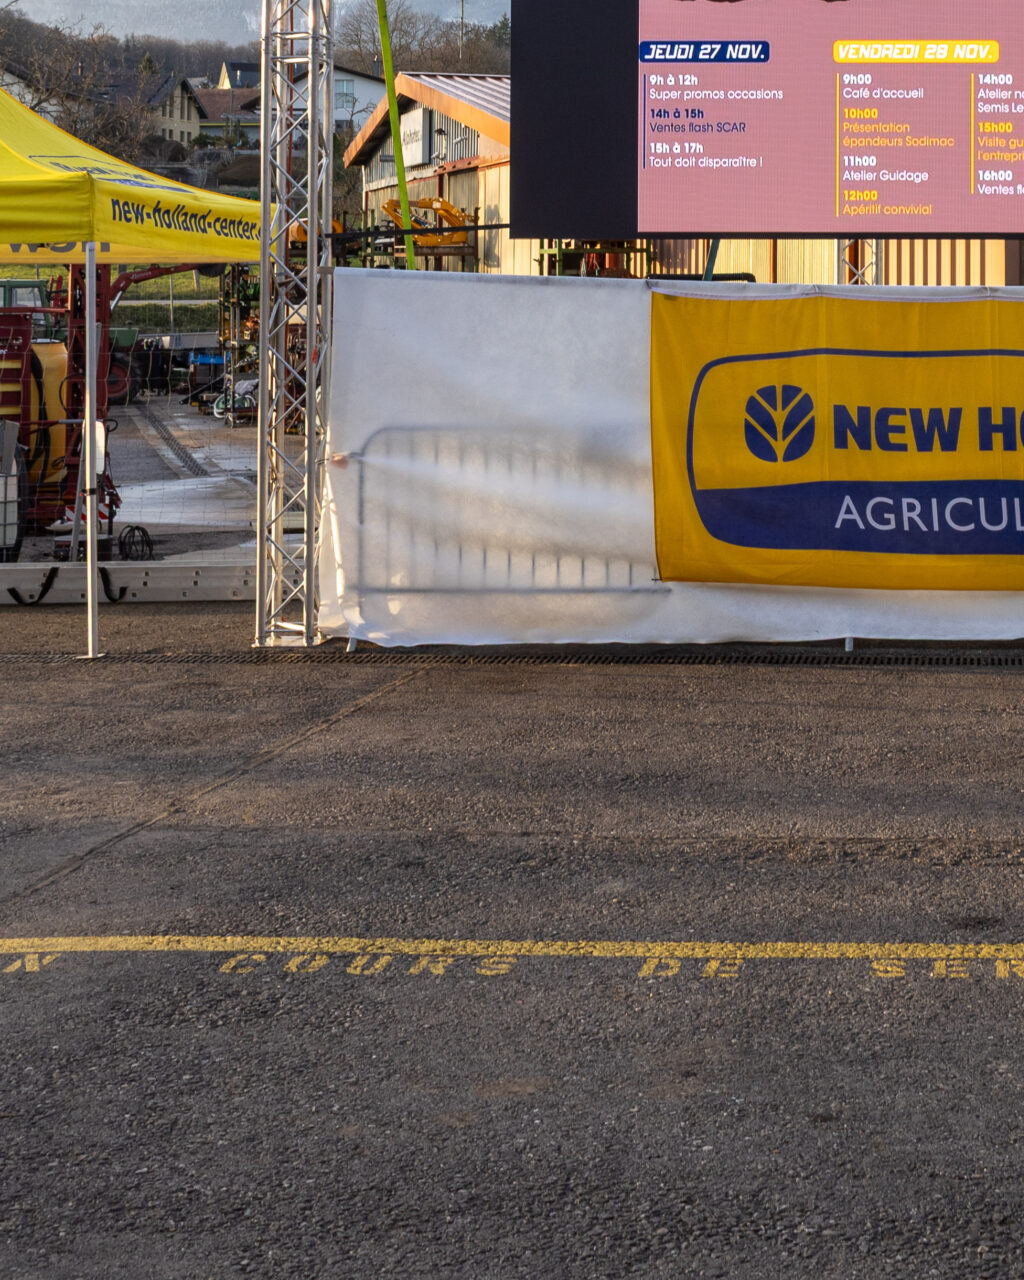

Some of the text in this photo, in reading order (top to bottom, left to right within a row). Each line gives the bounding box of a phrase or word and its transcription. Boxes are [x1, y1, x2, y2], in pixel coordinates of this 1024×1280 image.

[644, 44, 765, 59] JEUDI 27 NOV.
[838, 44, 993, 59] VENDREDI 28 NOV.
[650, 74, 698, 85] 9h à 12h
[843, 74, 872, 85] 9h00
[978, 74, 1013, 85] 14h00
[650, 89, 783, 101] Super promos occasions
[843, 87, 924, 99] Café d'accueil
[978, 88, 1012, 99] Atelier
[978, 102, 1010, 113] Semis
[650, 108, 704, 119] 14h à 15h
[843, 108, 878, 119] 10h00
[650, 122, 746, 133] Ventes flash SCAR
[843, 122, 910, 133] Présentation
[978, 122, 1013, 133] 15h00
[843, 136, 954, 148] épandeurs Sodimac
[978, 136, 1006, 147] Visite
[650, 142, 704, 153] 15h à 17h
[649, 157, 672, 167] Tout
[674, 157, 696, 167] doit
[698, 156, 757, 169] disparaître
[843, 156, 877, 166] 11h00
[843, 170, 929, 183] Atelier Guidage
[978, 170, 1013, 181] 16h00
[978, 184, 1014, 195] Ventes
[843, 190, 878, 201] 12h00
[843, 204, 932, 216] Apéritif convivial
[111, 197, 262, 241] new-holland-center.
[833, 404, 962, 453] NEW
[218, 951, 518, 977] COURS
[637, 957, 744, 979] DE
